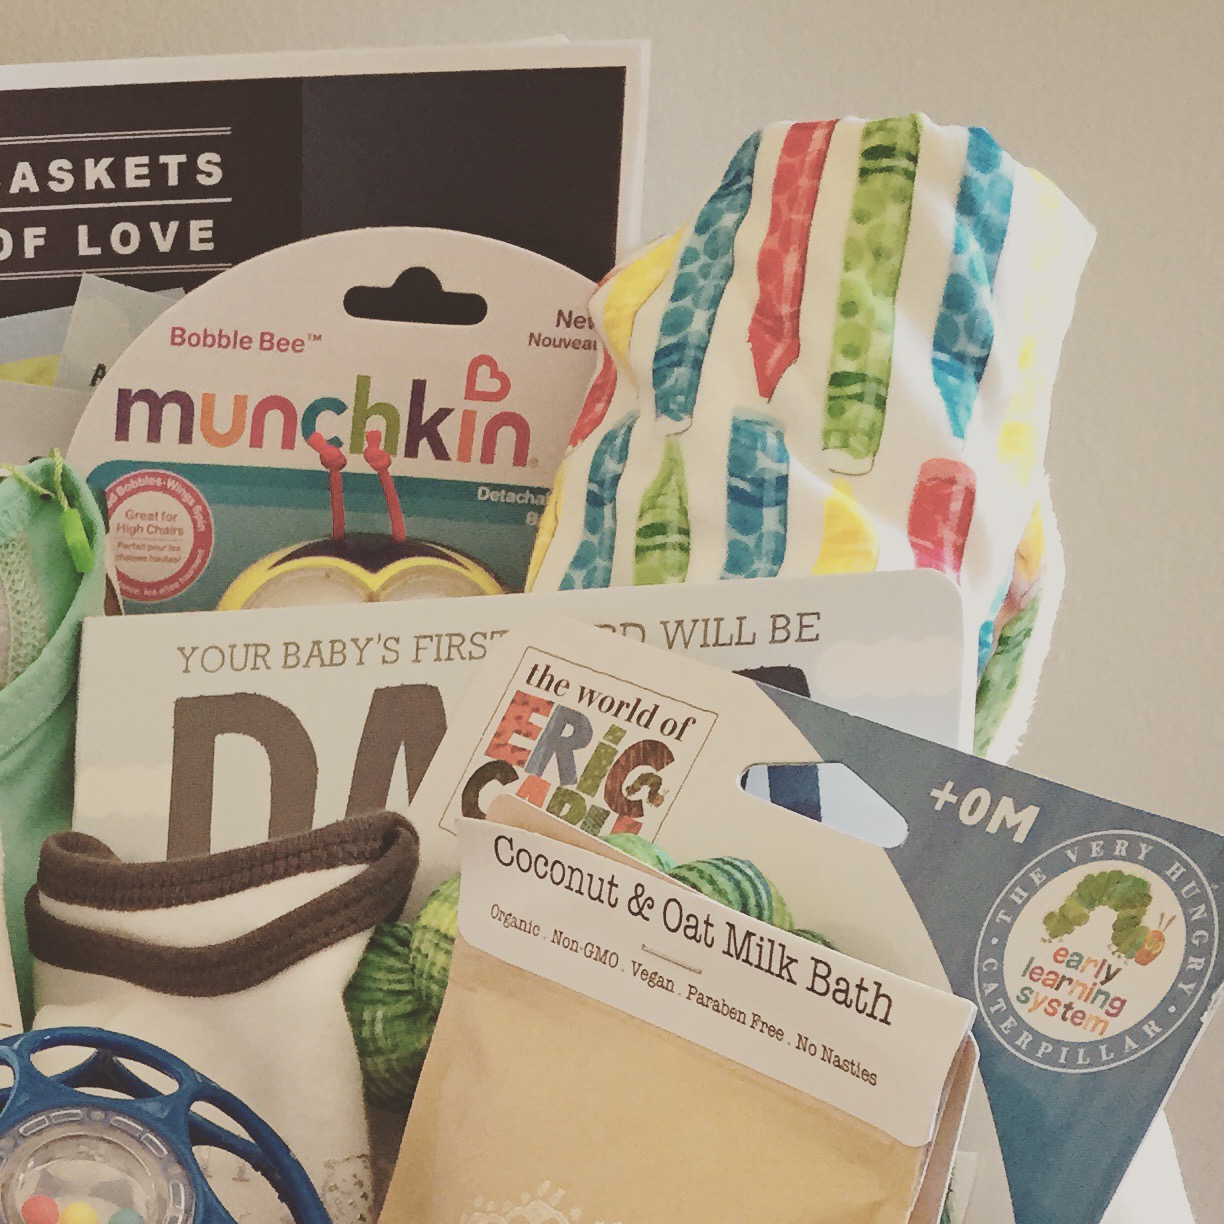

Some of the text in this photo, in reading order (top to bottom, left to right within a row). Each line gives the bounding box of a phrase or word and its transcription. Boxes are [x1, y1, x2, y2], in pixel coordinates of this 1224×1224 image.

[77, 218, 215, 257] LOVE
[169, 326, 253, 351] Bobble
[114, 356, 531, 467] munchkin
[116, 521, 185, 537] High Chairs
[124, 508, 179, 522] Great for
[176, 642, 272, 674] YOUR
[281, 632, 401, 670] BABY'S
[659, 615, 757, 650] WILL
[768, 611, 822, 645] BE
[524, 662, 698, 743] the world of
[492, 834, 895, 1027] Coconut & Oat Milk Bath
[995, 838, 1210, 997] THE VERY HUNGRY
[489, 903, 879, 1088] Organic Non-GMO Vegan Paraben Free No Nasties
[1021, 956, 1128, 1019] learning
[1052, 946, 1124, 986] early
[981, 957, 1164, 1066] CATERPILLAR
[1015, 985, 1110, 1037] system
